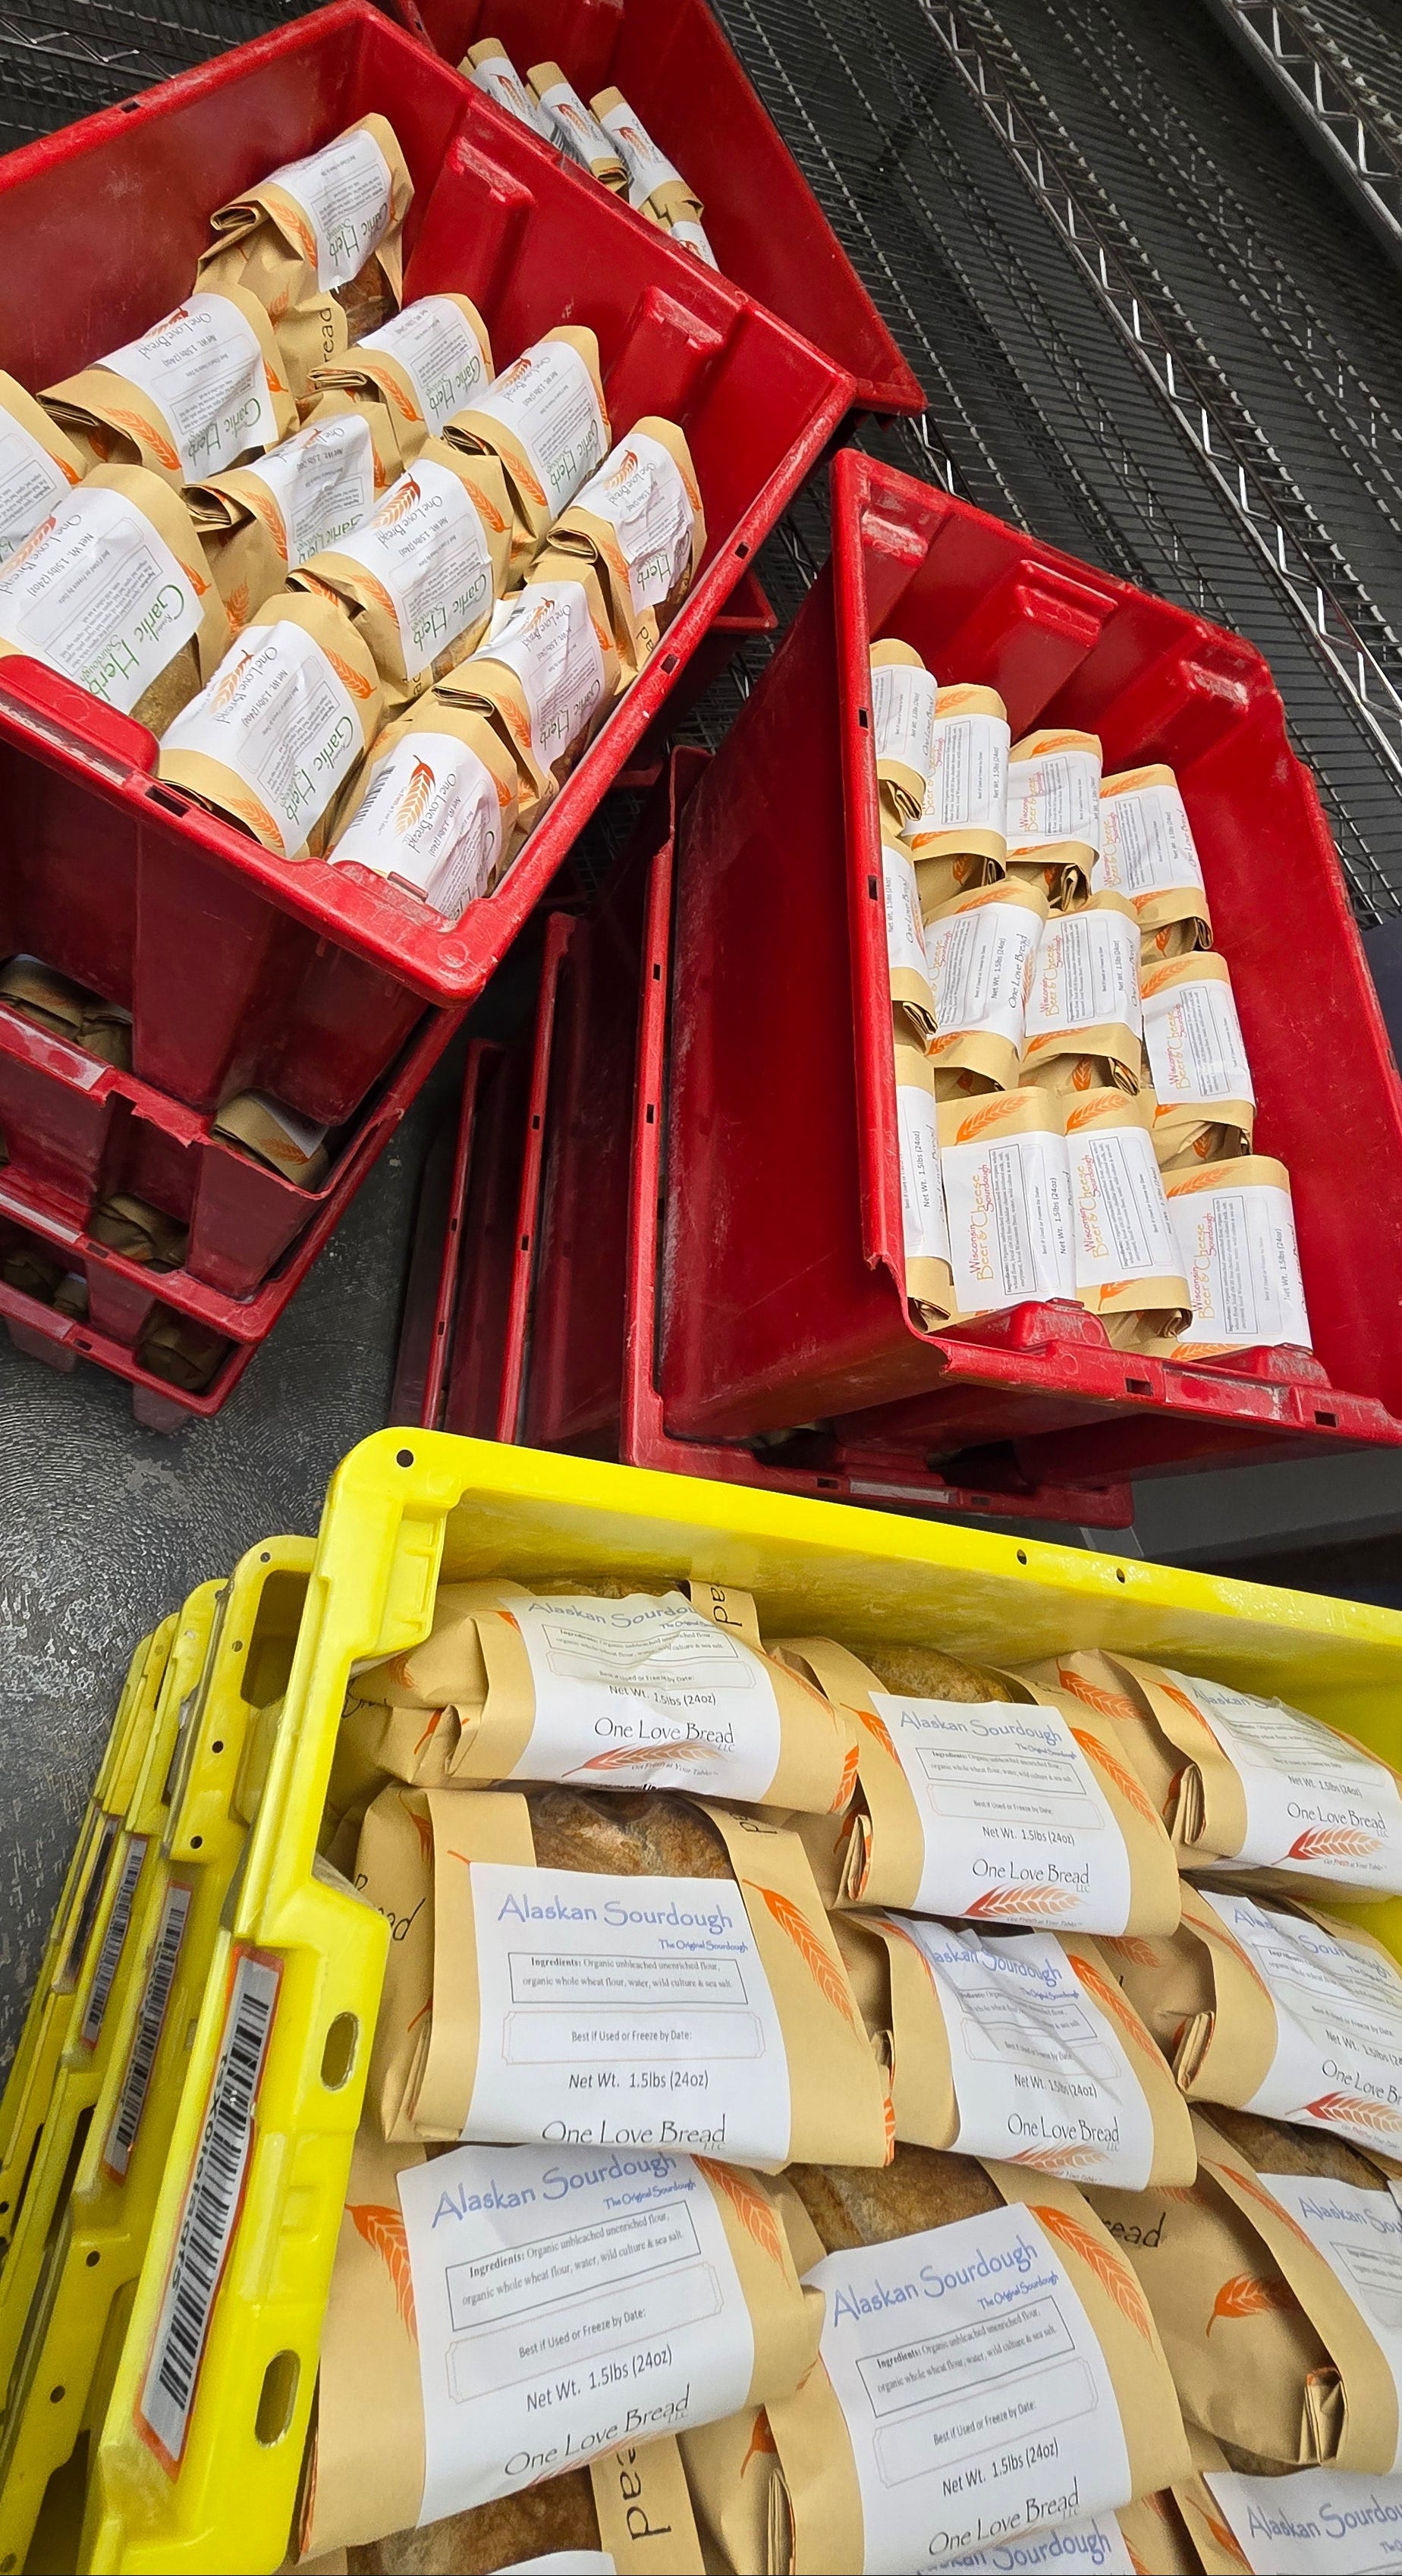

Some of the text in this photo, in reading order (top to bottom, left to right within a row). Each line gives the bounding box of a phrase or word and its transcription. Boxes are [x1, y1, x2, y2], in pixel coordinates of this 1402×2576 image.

[637, 554, 672, 591] Herb
[134, 584, 184, 642] Garlic
[454, 574, 486, 615] Garlic
[413, 607, 447, 652] Herb
[89, 639, 140, 701] Herb
[313, 716, 354, 771] Garlic
[286, 768, 316, 825] Herb
[408, 774, 456, 853] One Love Bread
[1008, 933, 1027, 1008] One Love Bread
[913, 1131, 923, 1152] (24oz)
[917, 1154, 926, 1175] 1.5lbs
[1084, 1154, 1101, 1197] Sourdough
[972, 1174, 987, 1229] Cheese
[978, 1164, 994, 1211] Sourdough
[1050, 1177, 1059, 1199] (24oz)
[1078, 1166, 1096, 1212] Cheese
[1053, 1202, 1061, 1221] 1.5lbs
[1079, 1207, 1094, 1252] Wisconsin
[970, 1224, 982, 1274] Wisconsin
[1089, 1223, 1109, 1258] Beer
[1193, 1224, 1210, 1268] Cheese
[1202, 1213, 1216, 1256] Sourdough
[976, 1242, 993, 1280] Beer
[1190, 1267, 1203, 1312] Wisconsin
[1199, 1284, 1215, 1321] Beer
[528, 1602, 606, 1624] Alaskan
[609, 1685, 716, 1706] Net Wt. 1.5lbs (24oz)
[1193, 1688, 1250, 1706] Alaskan
[595, 1717, 734, 1743] One Love Bread
[901, 1711, 1061, 1746] Alaskan Sourdough
[982, 1826, 1074, 1846] Net Wt. 1.5lbs (24oz)
[1287, 1802, 1387, 1830] One Love Bread
[973, 1858, 1089, 1884] One Love Bread
[497, 1893, 733, 1935] Alaskan Sourdough
[531, 1957, 720, 1972] Ingredients: Organic unbleached unenriched flour,
[659, 1939, 748, 1952] The Original Sourdough
[522, 1976, 553, 1987] organic
[555, 1975, 579, 1986] whole
[581, 1976, 603, 1987] wheat
[605, 1977, 627, 1989] flour,
[628, 1978, 651, 1989] water,
[652, 1977, 669, 1987] wild
[671, 1978, 696, 1988] culture
[698, 1979, 703, 1987] &
[718, 1979, 731, 1987] salt
[571, 2030, 692, 2044] Best if Used or Freeze by Date:
[568, 2070, 709, 2091] Net Wt. 1.5lbs (24oz)
[1322, 2059, 1384, 2099] One Love
[542, 2114, 726, 2144] One Love Bread
[1007, 2113, 1120, 2141] One Love Bread
[432, 2152, 677, 2229] Alaskan Sourdough
[605, 2179, 696, 2210] The Original Sourdough
[1299, 2197, 1366, 2225] Alaskan
[470, 2212, 670, 2278] Ingredients: Organic unbleached unenriched flour,
[462, 2231, 683, 2307] organic whole wheat flour, water, wild culture & sea salt
[833, 2235, 1037, 2327] Alaskan Sourdough
[519, 2307, 646, 2358] Best if Used or Freeze by Date:
[527, 2344, 672, 2412] Net Wt. 1.5lbs (24oz)
[505, 2383, 690, 2476] One Love Bread
[943, 2438, 1058, 2496] Net Wt. 1.5lbs (24oz)
[929, 2476, 1079, 2556] One Love Bread
[1246, 2504, 1320, 2540] Alaskan
